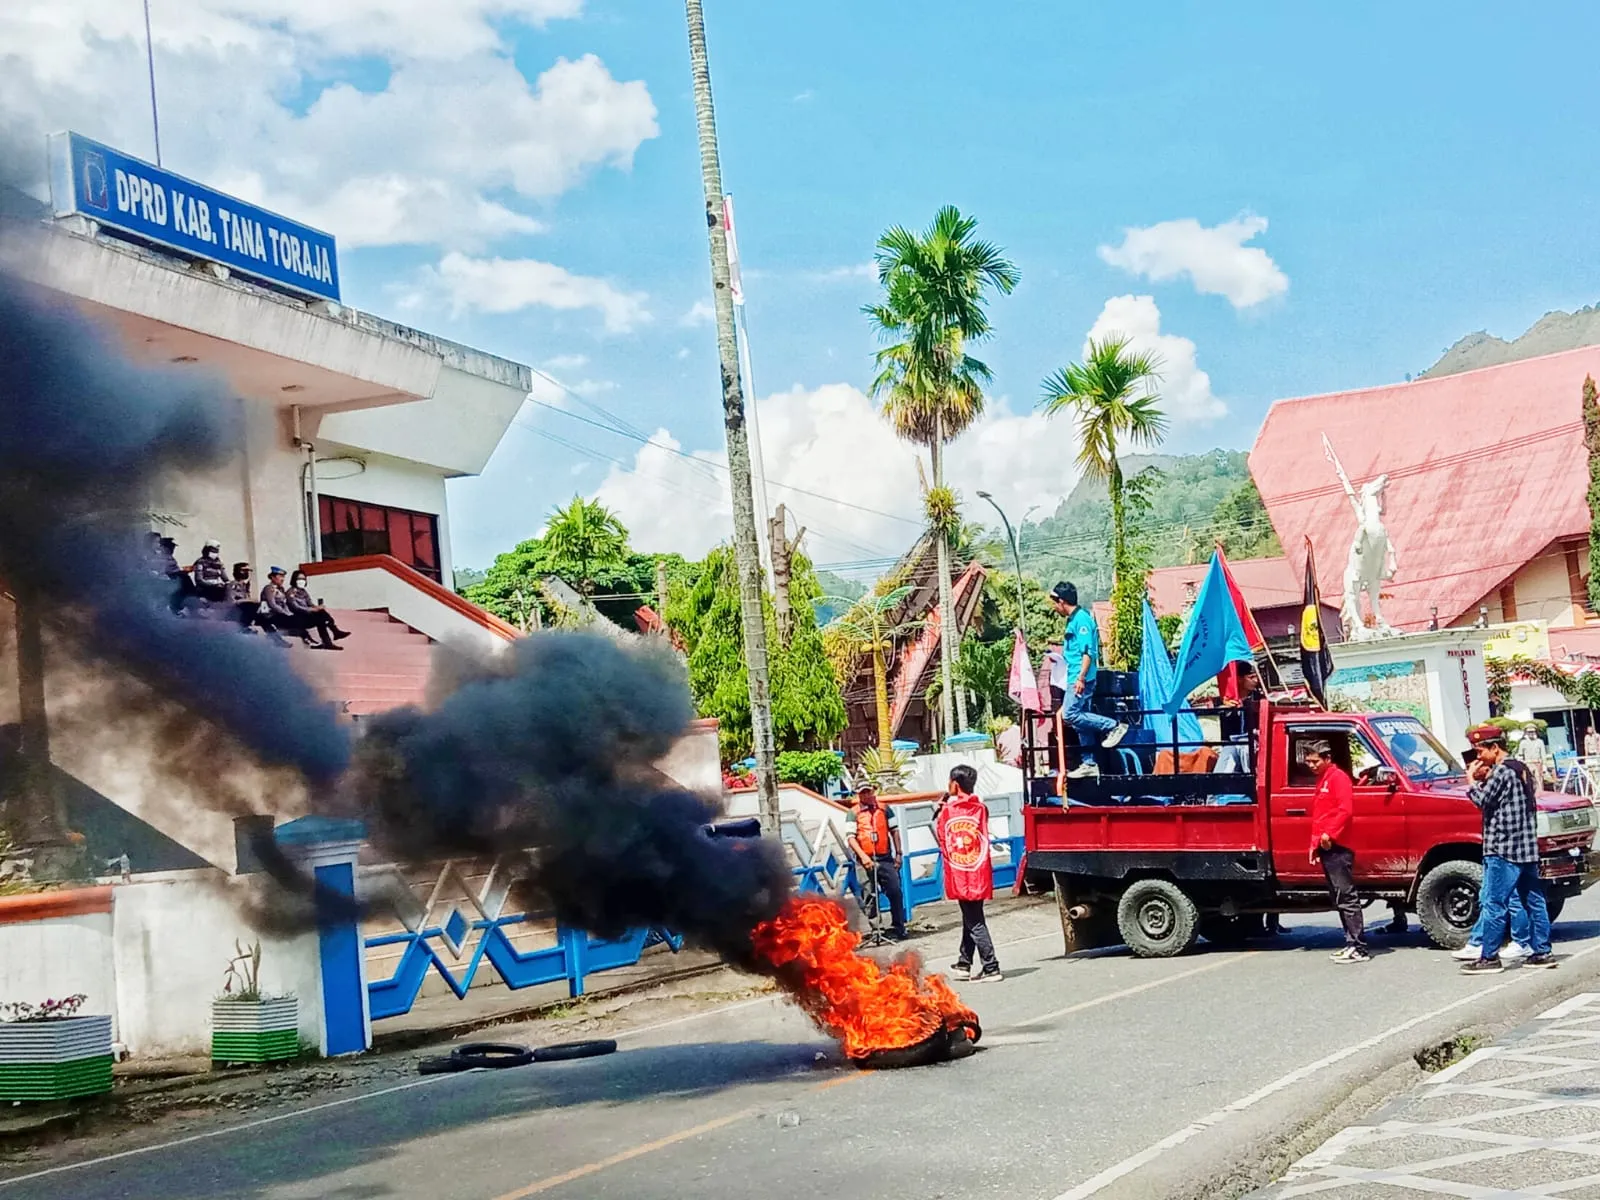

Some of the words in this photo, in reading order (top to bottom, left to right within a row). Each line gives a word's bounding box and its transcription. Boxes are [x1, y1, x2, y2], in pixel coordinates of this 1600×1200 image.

[115, 168, 168, 226] DPRD
[171, 190, 217, 245] KAB.
[219, 207, 267, 262] TANA
[268, 227, 333, 285] TORAJA
